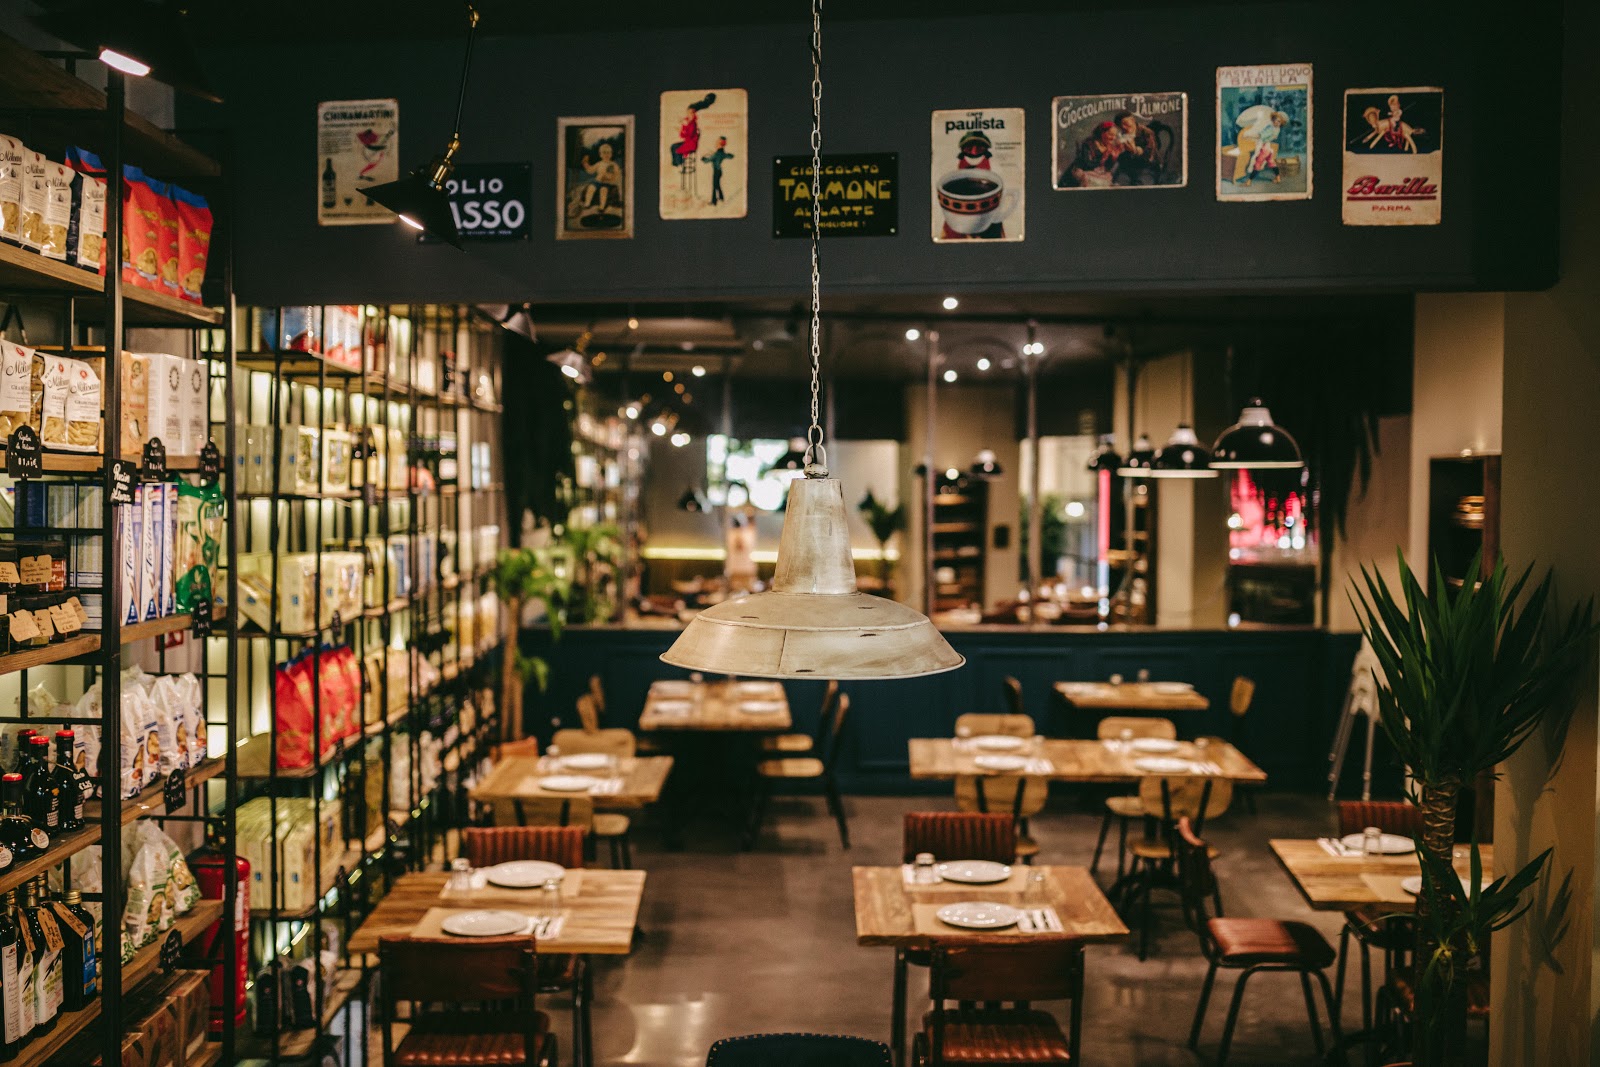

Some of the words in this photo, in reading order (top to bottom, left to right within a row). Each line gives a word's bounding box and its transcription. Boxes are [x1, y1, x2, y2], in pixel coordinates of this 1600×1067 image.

[1280, 66, 1312, 77] UOVO
[1130, 95, 1182, 121] TALMONE
[945, 117, 1006, 134] paulista
[445, 178, 504, 195] OLIO
[1346, 175, 1439, 196] Barilla
[820, 205, 875, 217] LATTE
[1371, 204, 1413, 212] PARMA
